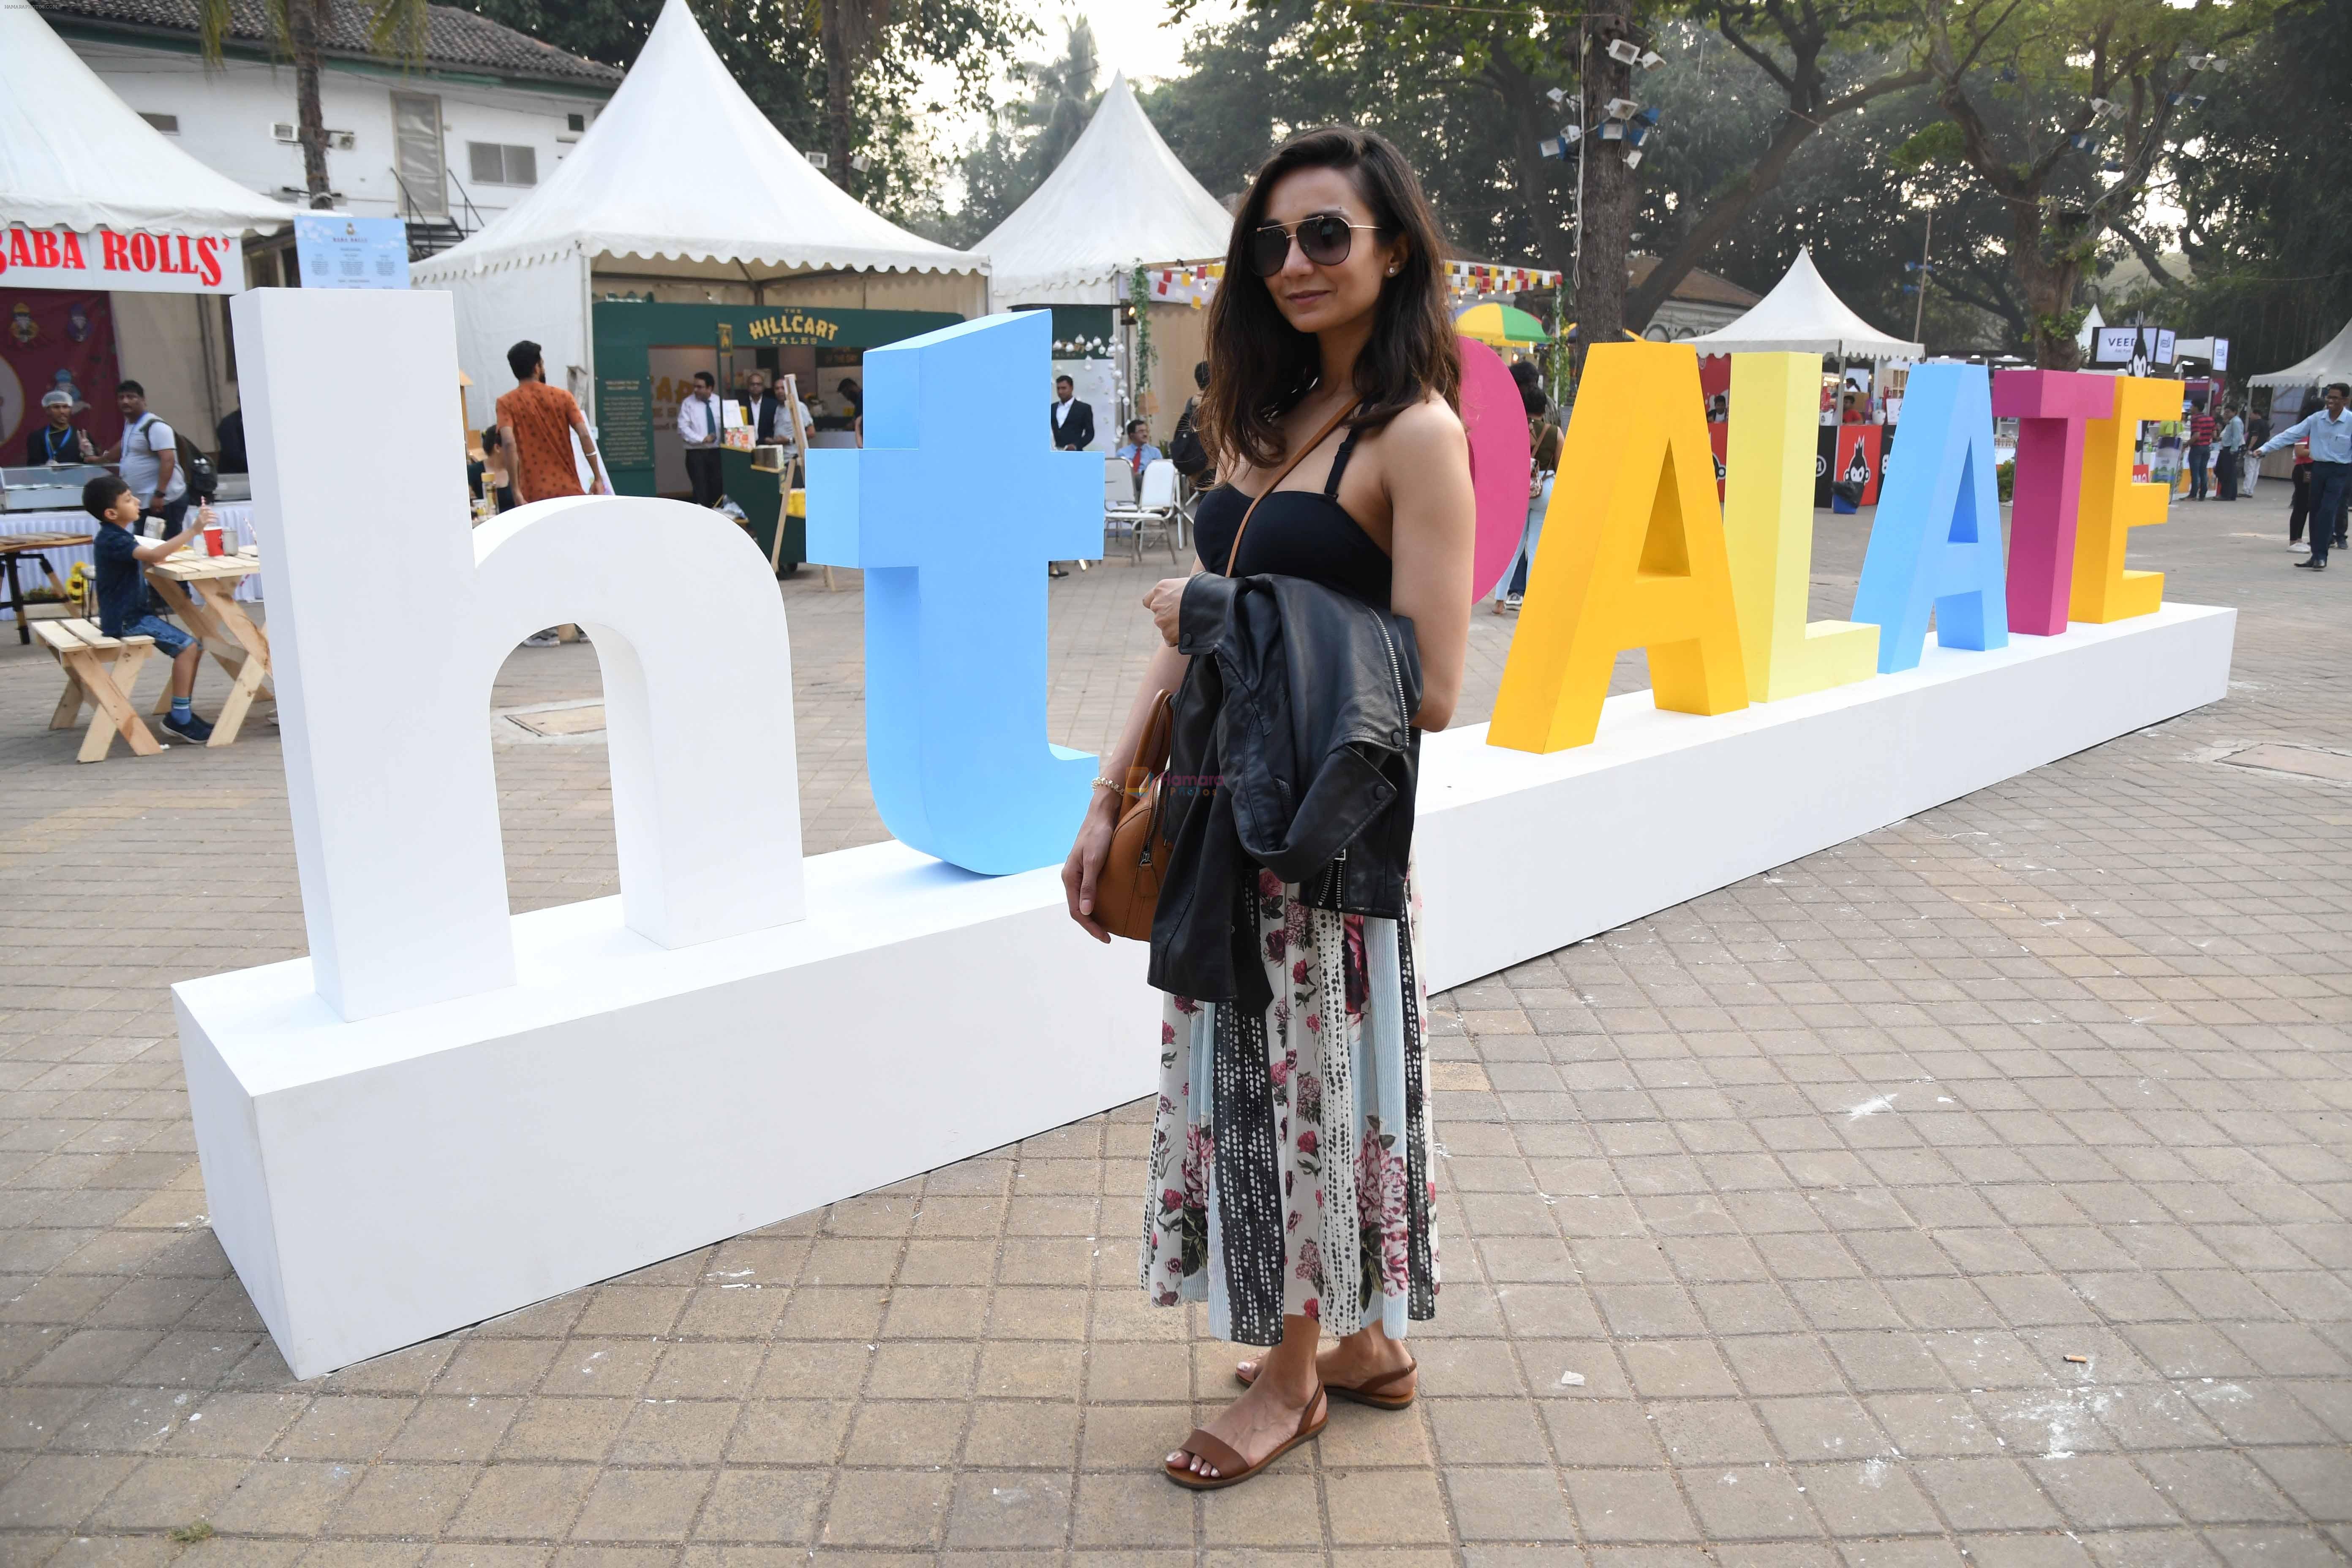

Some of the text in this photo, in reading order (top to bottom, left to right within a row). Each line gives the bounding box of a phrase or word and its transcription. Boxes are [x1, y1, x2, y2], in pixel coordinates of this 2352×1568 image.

[0, 229, 86, 275] ABA
[749, 315, 838, 341] HILLCART
[770, 336, 818, 345] TALES
